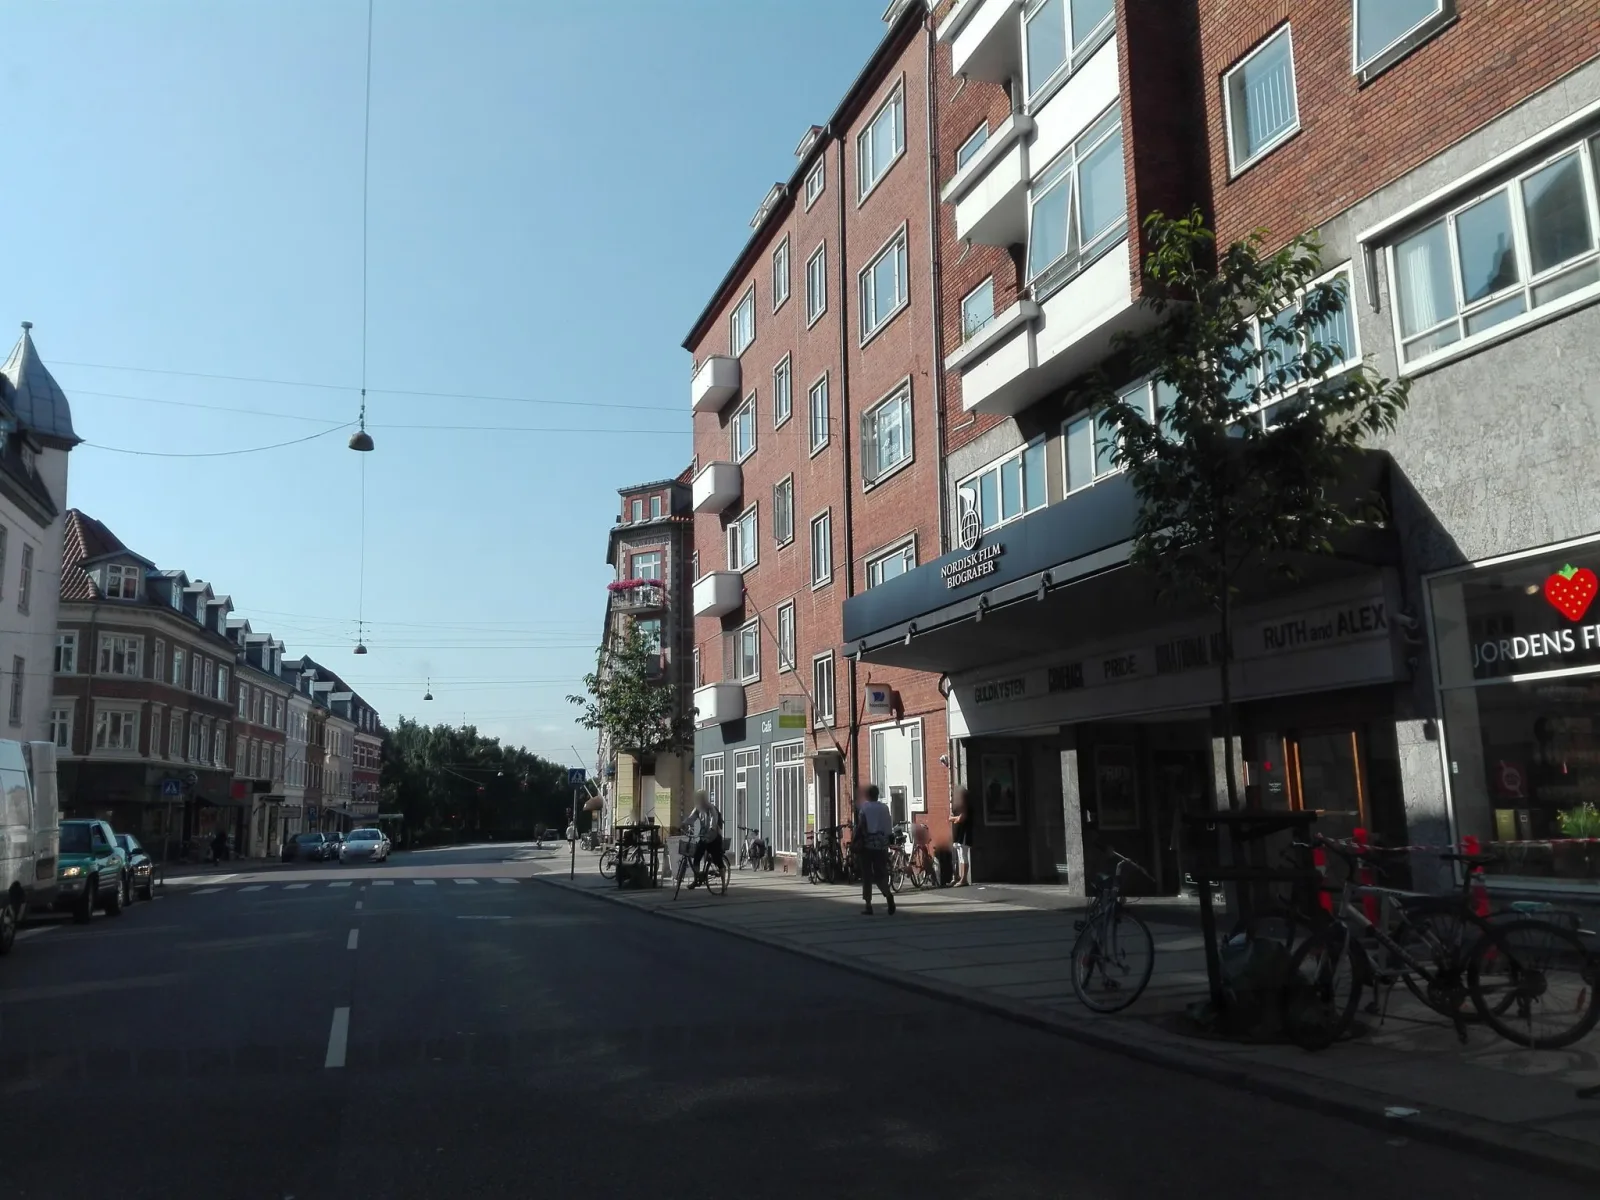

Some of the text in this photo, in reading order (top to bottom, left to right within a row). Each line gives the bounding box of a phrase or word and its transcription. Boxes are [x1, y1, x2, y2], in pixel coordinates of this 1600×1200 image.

[940, 543, 1002, 578] NORDISK FILM
[947, 560, 995, 589] BIOGRAFER
[1263, 603, 1387, 649] RUTH and ALEX
[1474, 629, 1576, 668] JORDENS
[1103, 653, 1138, 679] PRIDE
[974, 677, 1026, 703] GULDKYSTEN
[761, 719, 772, 733] Café
